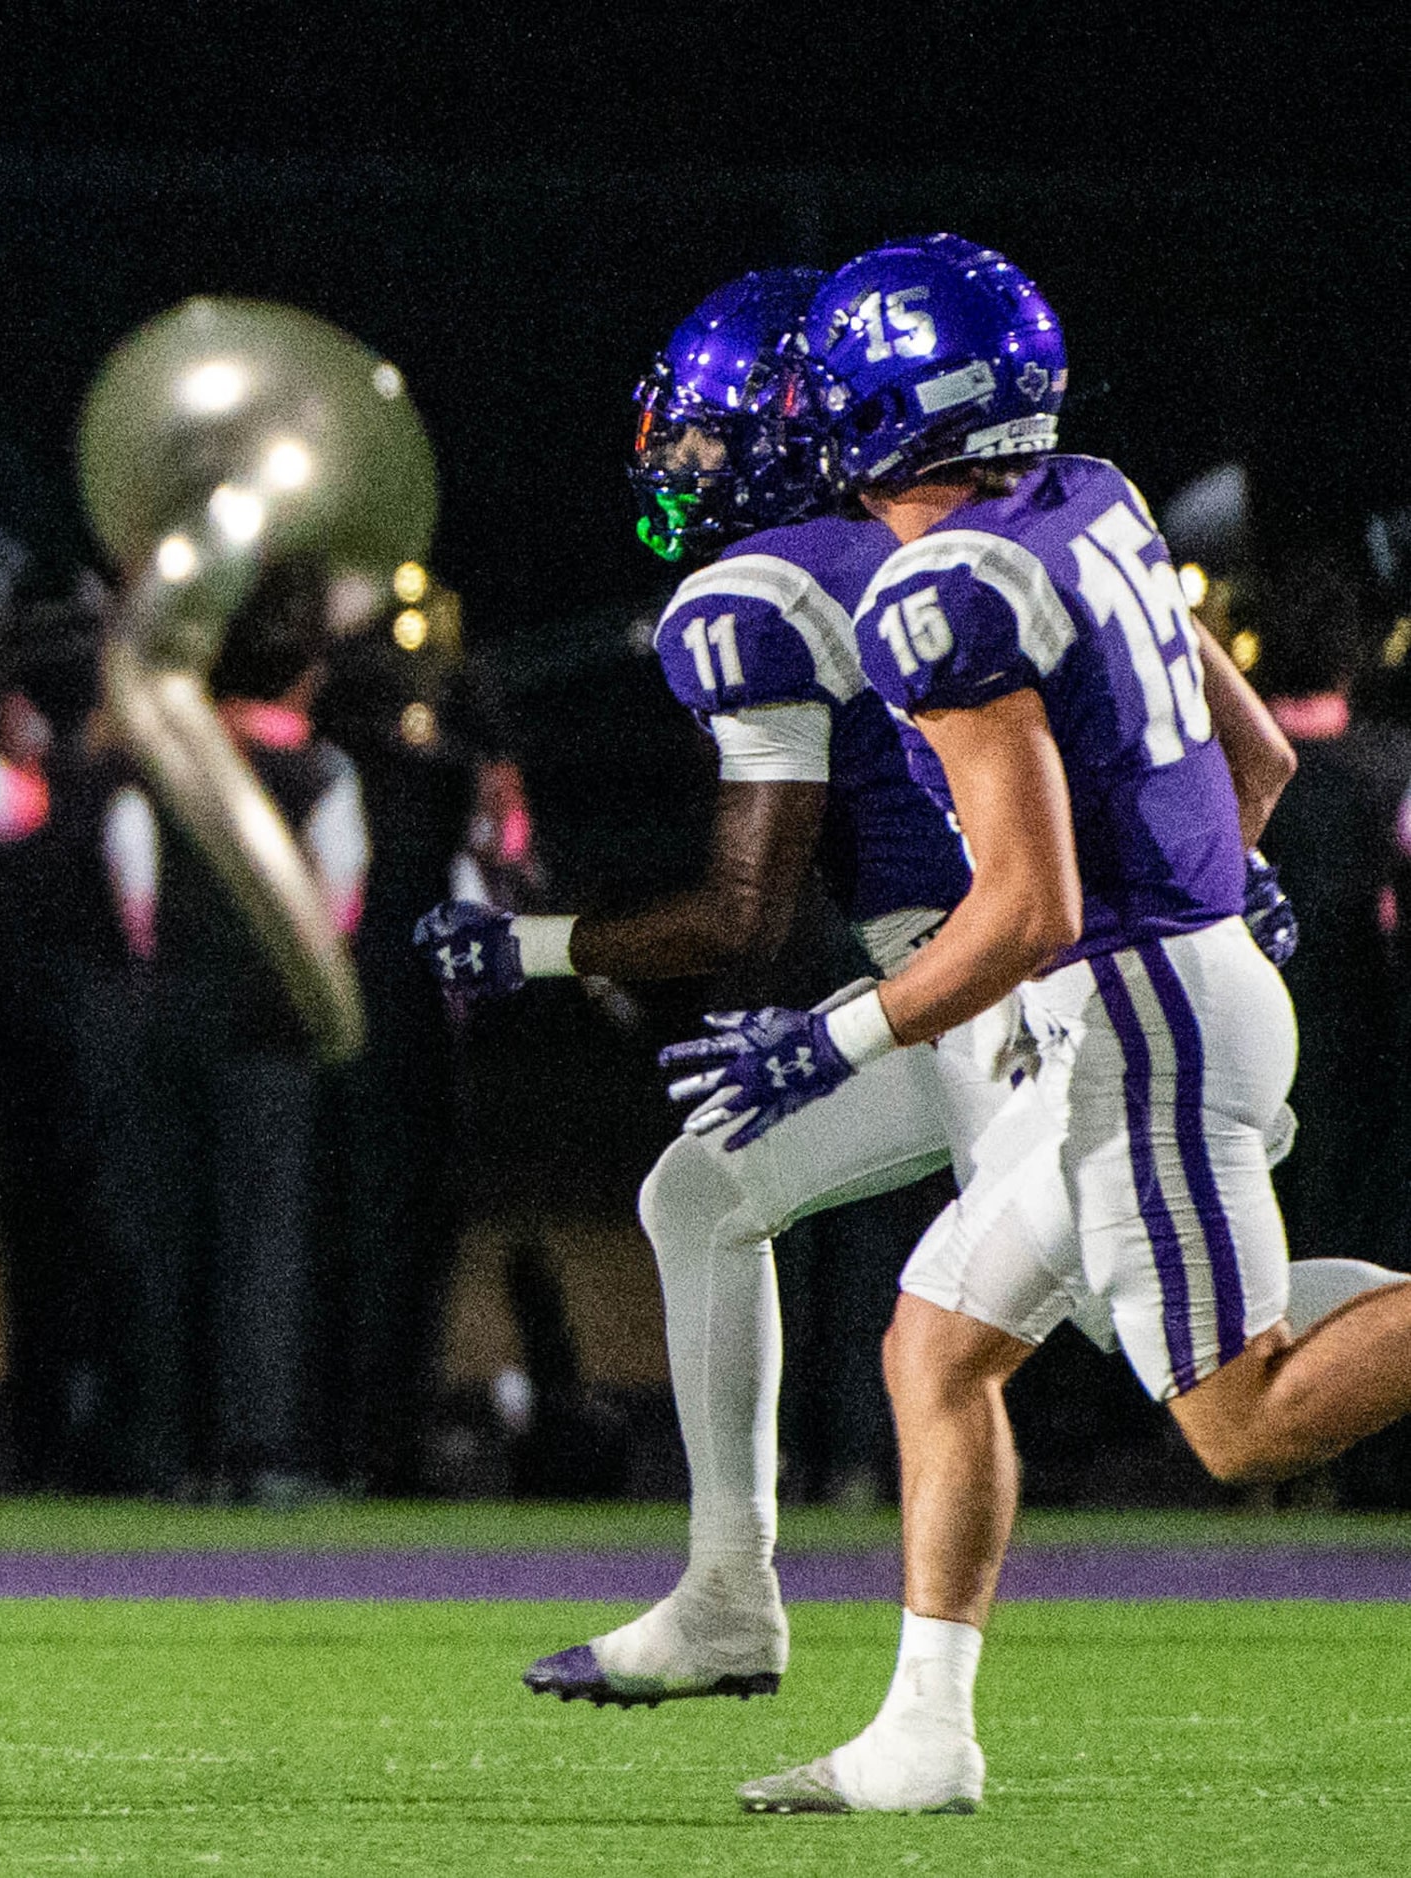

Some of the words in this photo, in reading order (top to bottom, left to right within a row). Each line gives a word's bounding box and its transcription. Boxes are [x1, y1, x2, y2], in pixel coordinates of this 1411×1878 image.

[857, 284, 938, 363] 15
[682, 614, 745, 691] 11
[878, 585, 955, 677] 15
[1067, 502, 1211, 768] 15
